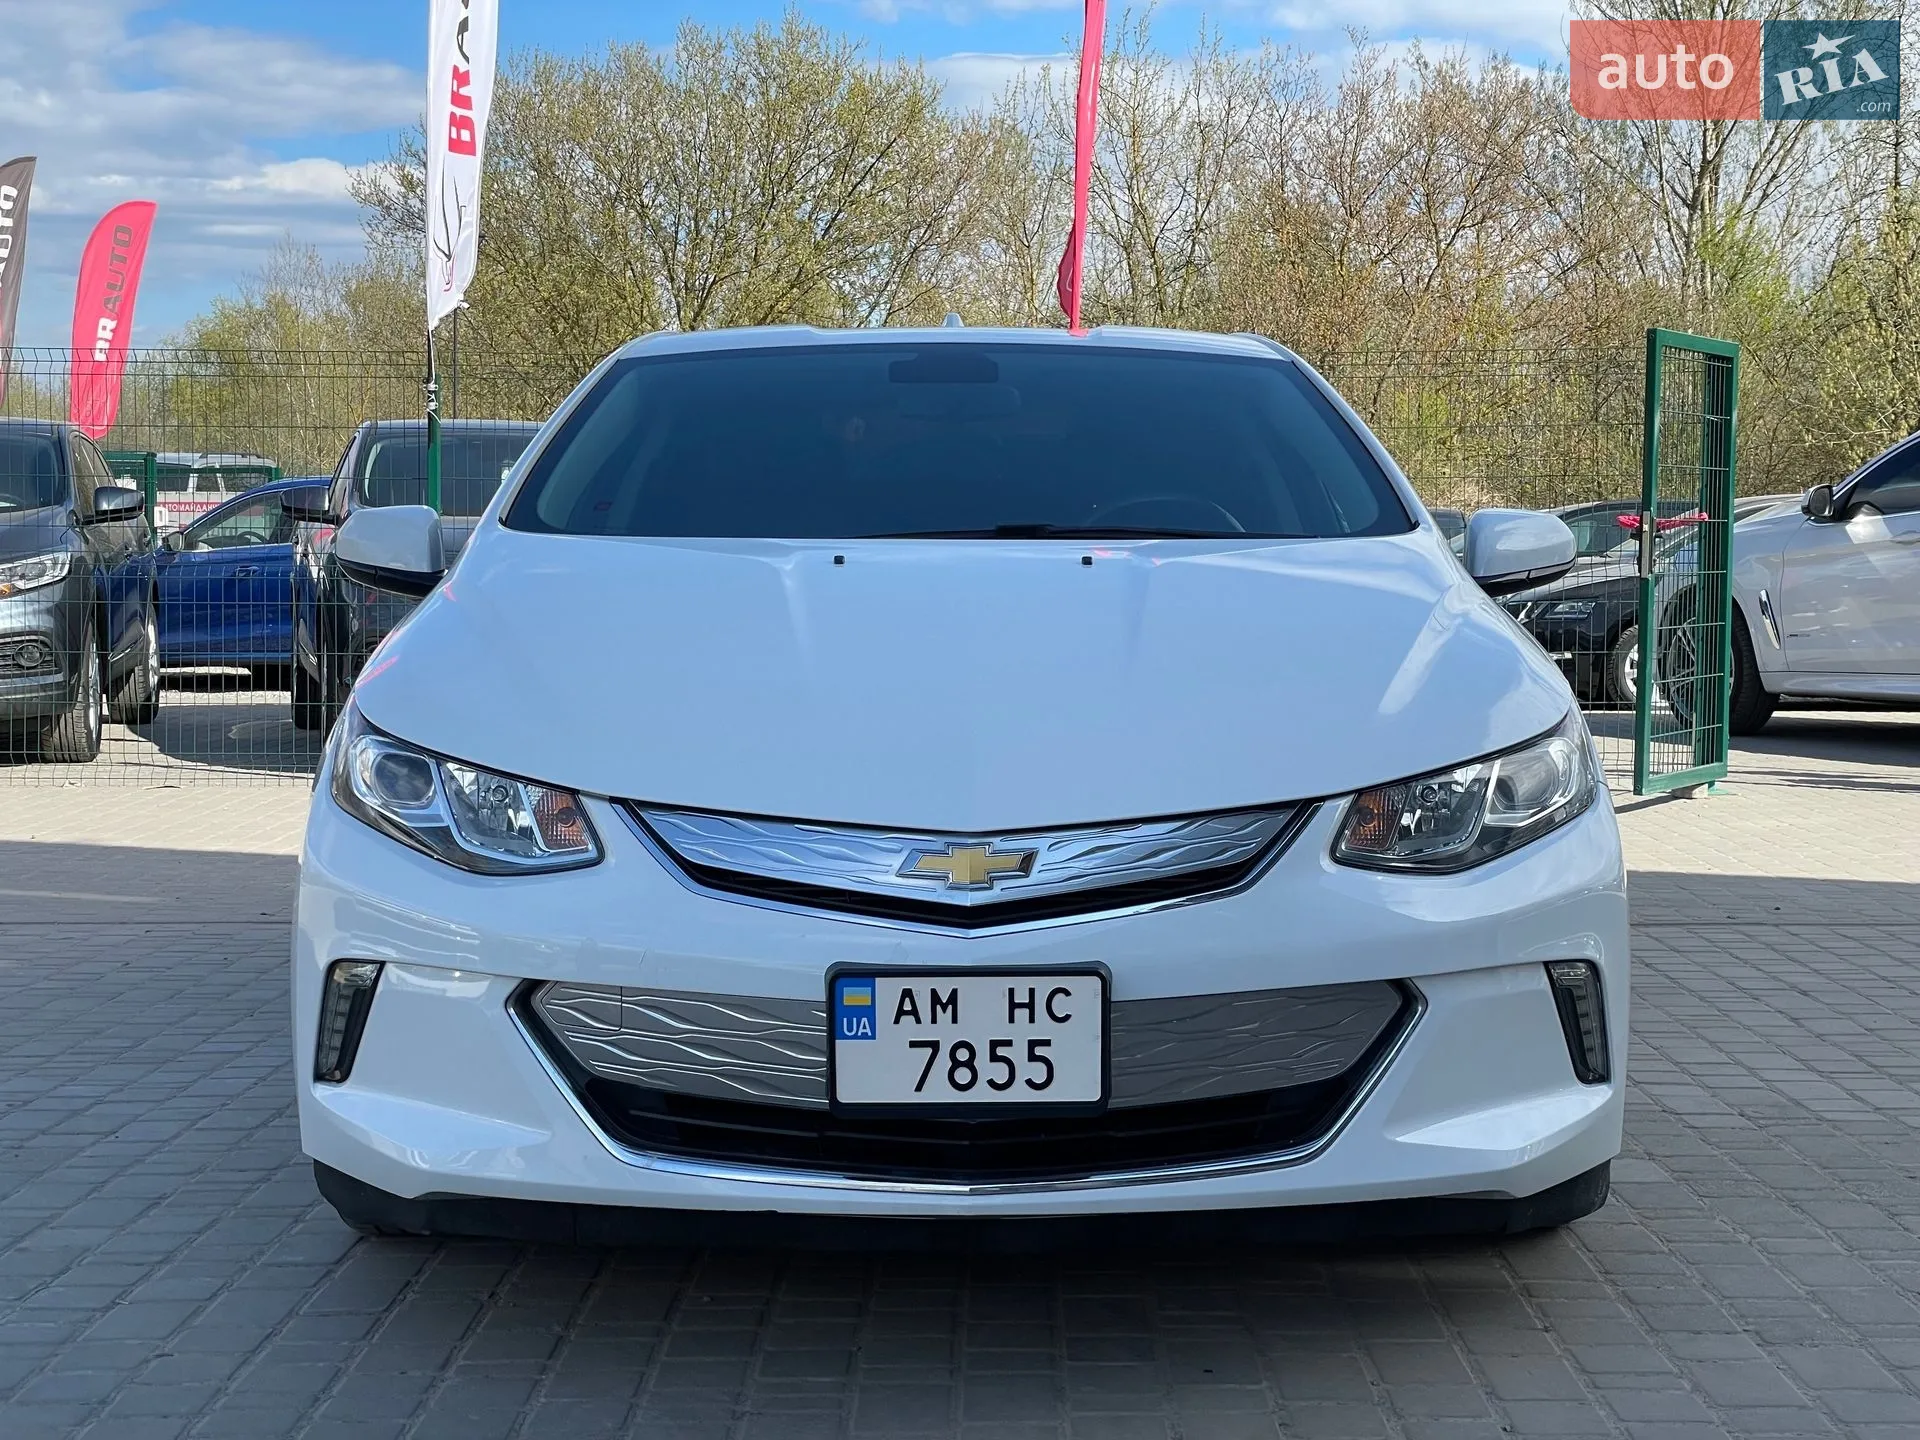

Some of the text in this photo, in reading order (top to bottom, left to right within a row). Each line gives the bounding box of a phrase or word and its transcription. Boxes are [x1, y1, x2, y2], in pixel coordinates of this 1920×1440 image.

[893, 986, 1073, 1025] AM HC
[843, 1017, 872, 1036] UA
[908, 1038, 1055, 1093] 7855
